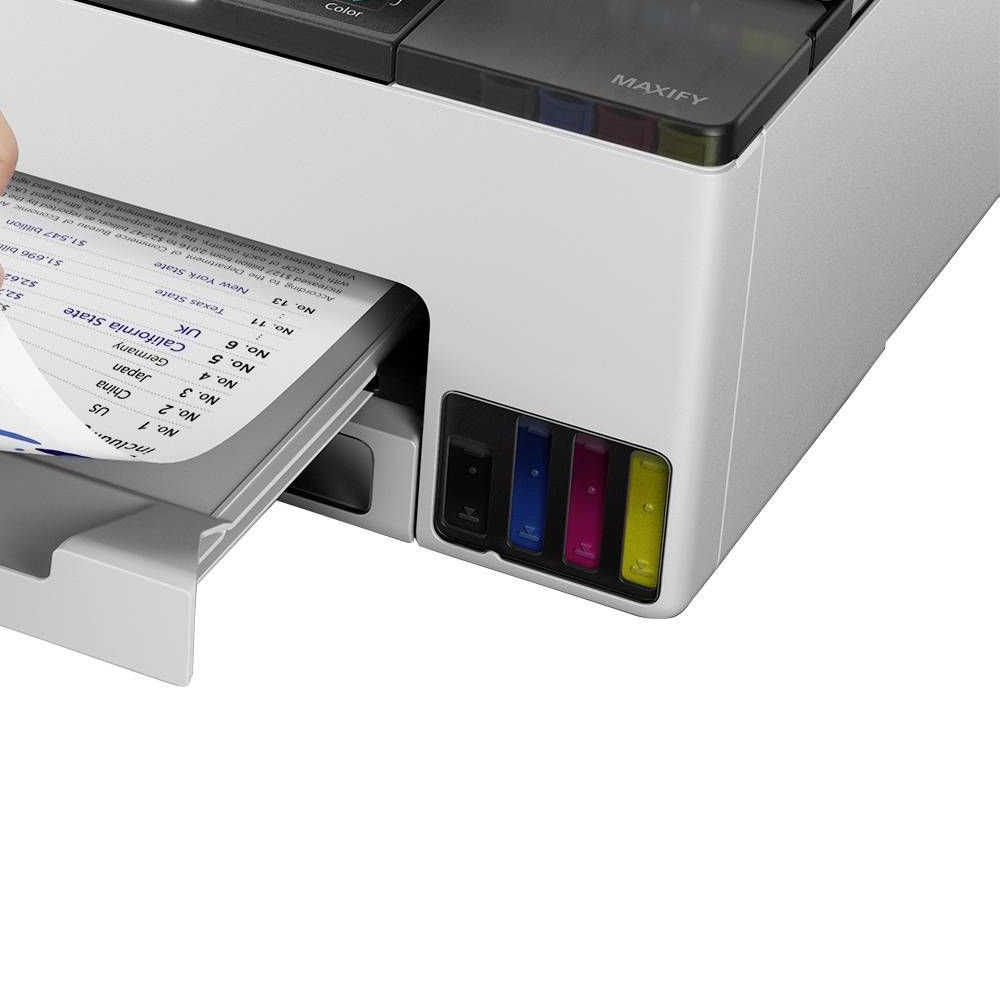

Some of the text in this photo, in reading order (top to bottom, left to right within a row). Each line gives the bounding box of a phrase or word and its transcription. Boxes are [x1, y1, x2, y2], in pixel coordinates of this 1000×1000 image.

[325, 2, 364, 18] Color
[610, 74, 708, 105] MAXIFY
[52, 188, 104, 206] Hollywood
[13, 204, 60, 222] Economic
[40, 202, 82, 218] reported
[84, 206, 100, 216] the
[116, 206, 182, 228] entertainment
[102, 211, 152, 230] surpassed
[77, 222, 112, 236] Bureau
[154, 227, 178, 237] state
[115, 233, 168, 252] Commerce
[180, 234, 198, 242] the
[224, 238, 269, 254] industries
[21, 250, 63, 266] $1.696
[209, 252, 233, 262] from
[242, 252, 267, 262] each
[284, 255, 322, 270] clusters
[6, 220, 316, 314] No. 13 New York State $1.547 billion
[186, 254, 245, 276] Department
[234, 260, 265, 272] billion
[282, 264, 306, 274] GDP
[248, 272, 266, 282] the
[266, 268, 293, 280] $127
[307, 271, 326, 280] the
[269, 278, 281, 286] to
[294, 276, 342, 295] increased
[328, 277, 350, 288] with
[154, 288, 188, 304] State
[284, 282, 336, 302] According
[190, 300, 224, 316] Texas
[64, 308, 106, 326] State
[251, 318, 266, 327] 11
[109, 322, 186, 352] California
[174, 324, 202, 338] UK
[274, 324, 294, 336] No.
[225, 340, 238, 350] 6
[246, 345, 270, 358] No.
[112, 342, 168, 367] Germany
[208, 354, 224, 364] 5
[230, 359, 256, 374] No.
[199, 372, 211, 381] 4
[216, 376, 238, 390] No.
[112, 363, 220, 406] No. 3 Japan
[96, 380, 200, 422] No. 2 China
[88, 404, 179, 437] No. 1 US
